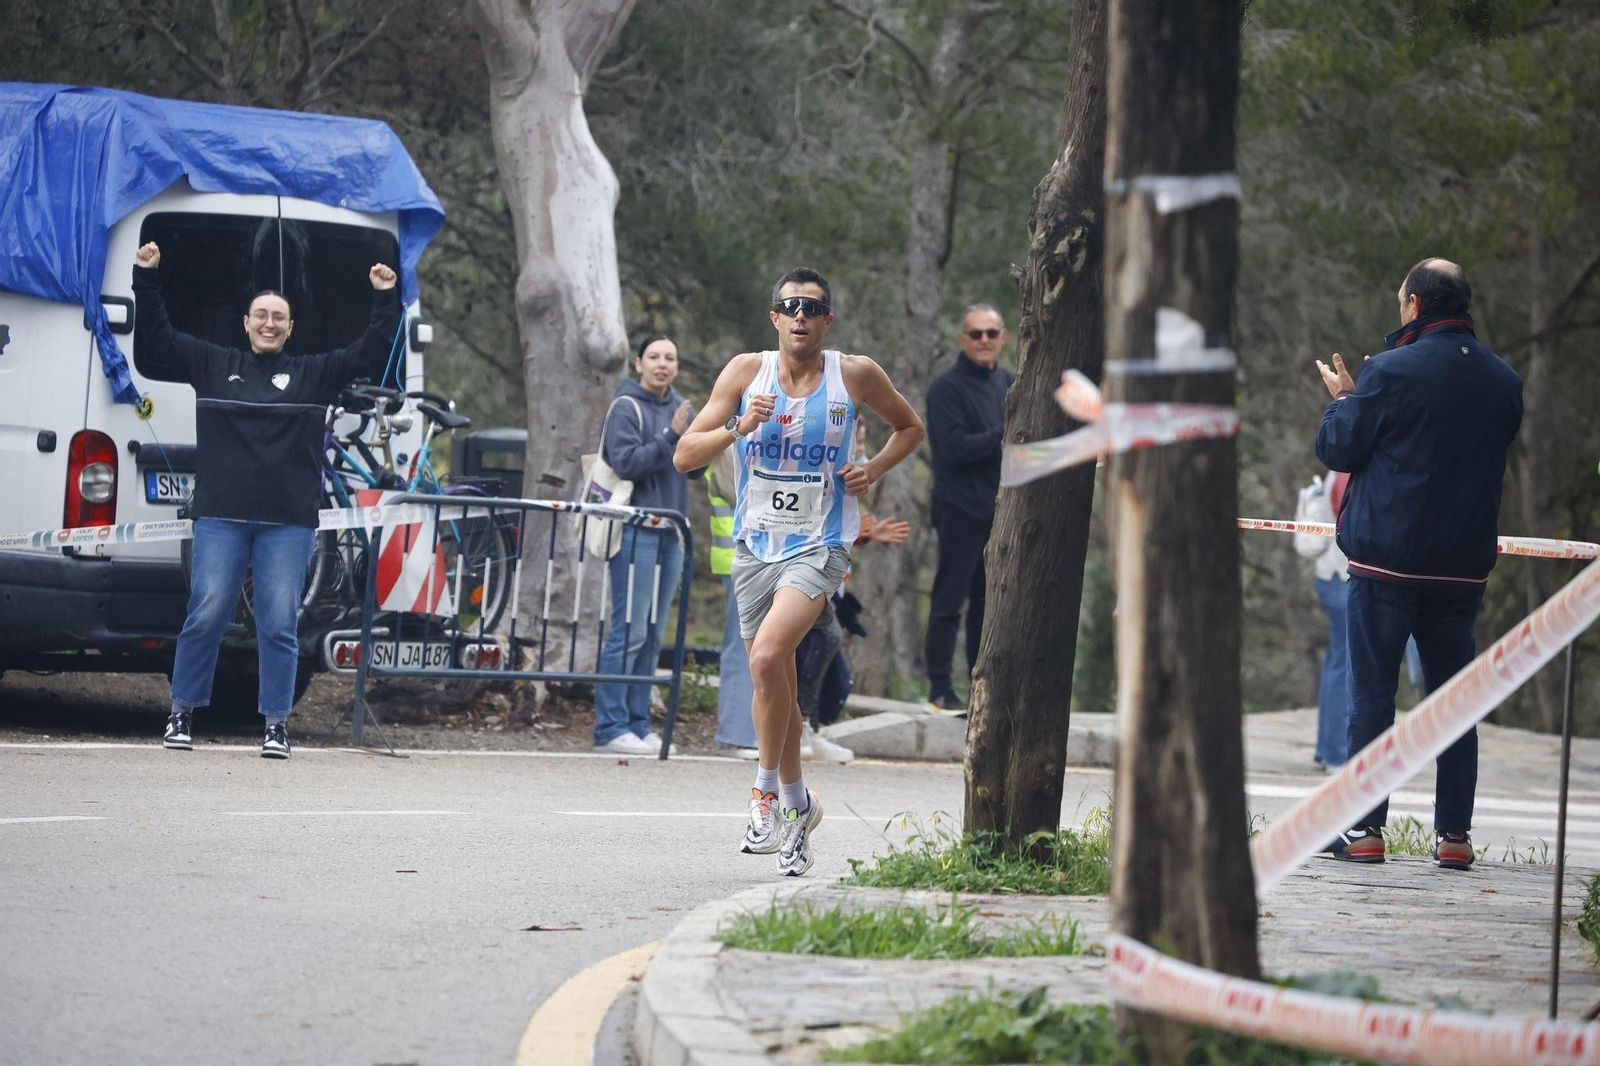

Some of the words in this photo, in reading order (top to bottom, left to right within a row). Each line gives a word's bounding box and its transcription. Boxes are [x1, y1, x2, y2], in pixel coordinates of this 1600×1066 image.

[159, 475, 181, 497] SN
[772, 490, 800, 512] 62
[373, 644, 394, 665] SN
[402, 644, 420, 666] JA
[425, 645, 451, 667] 187
